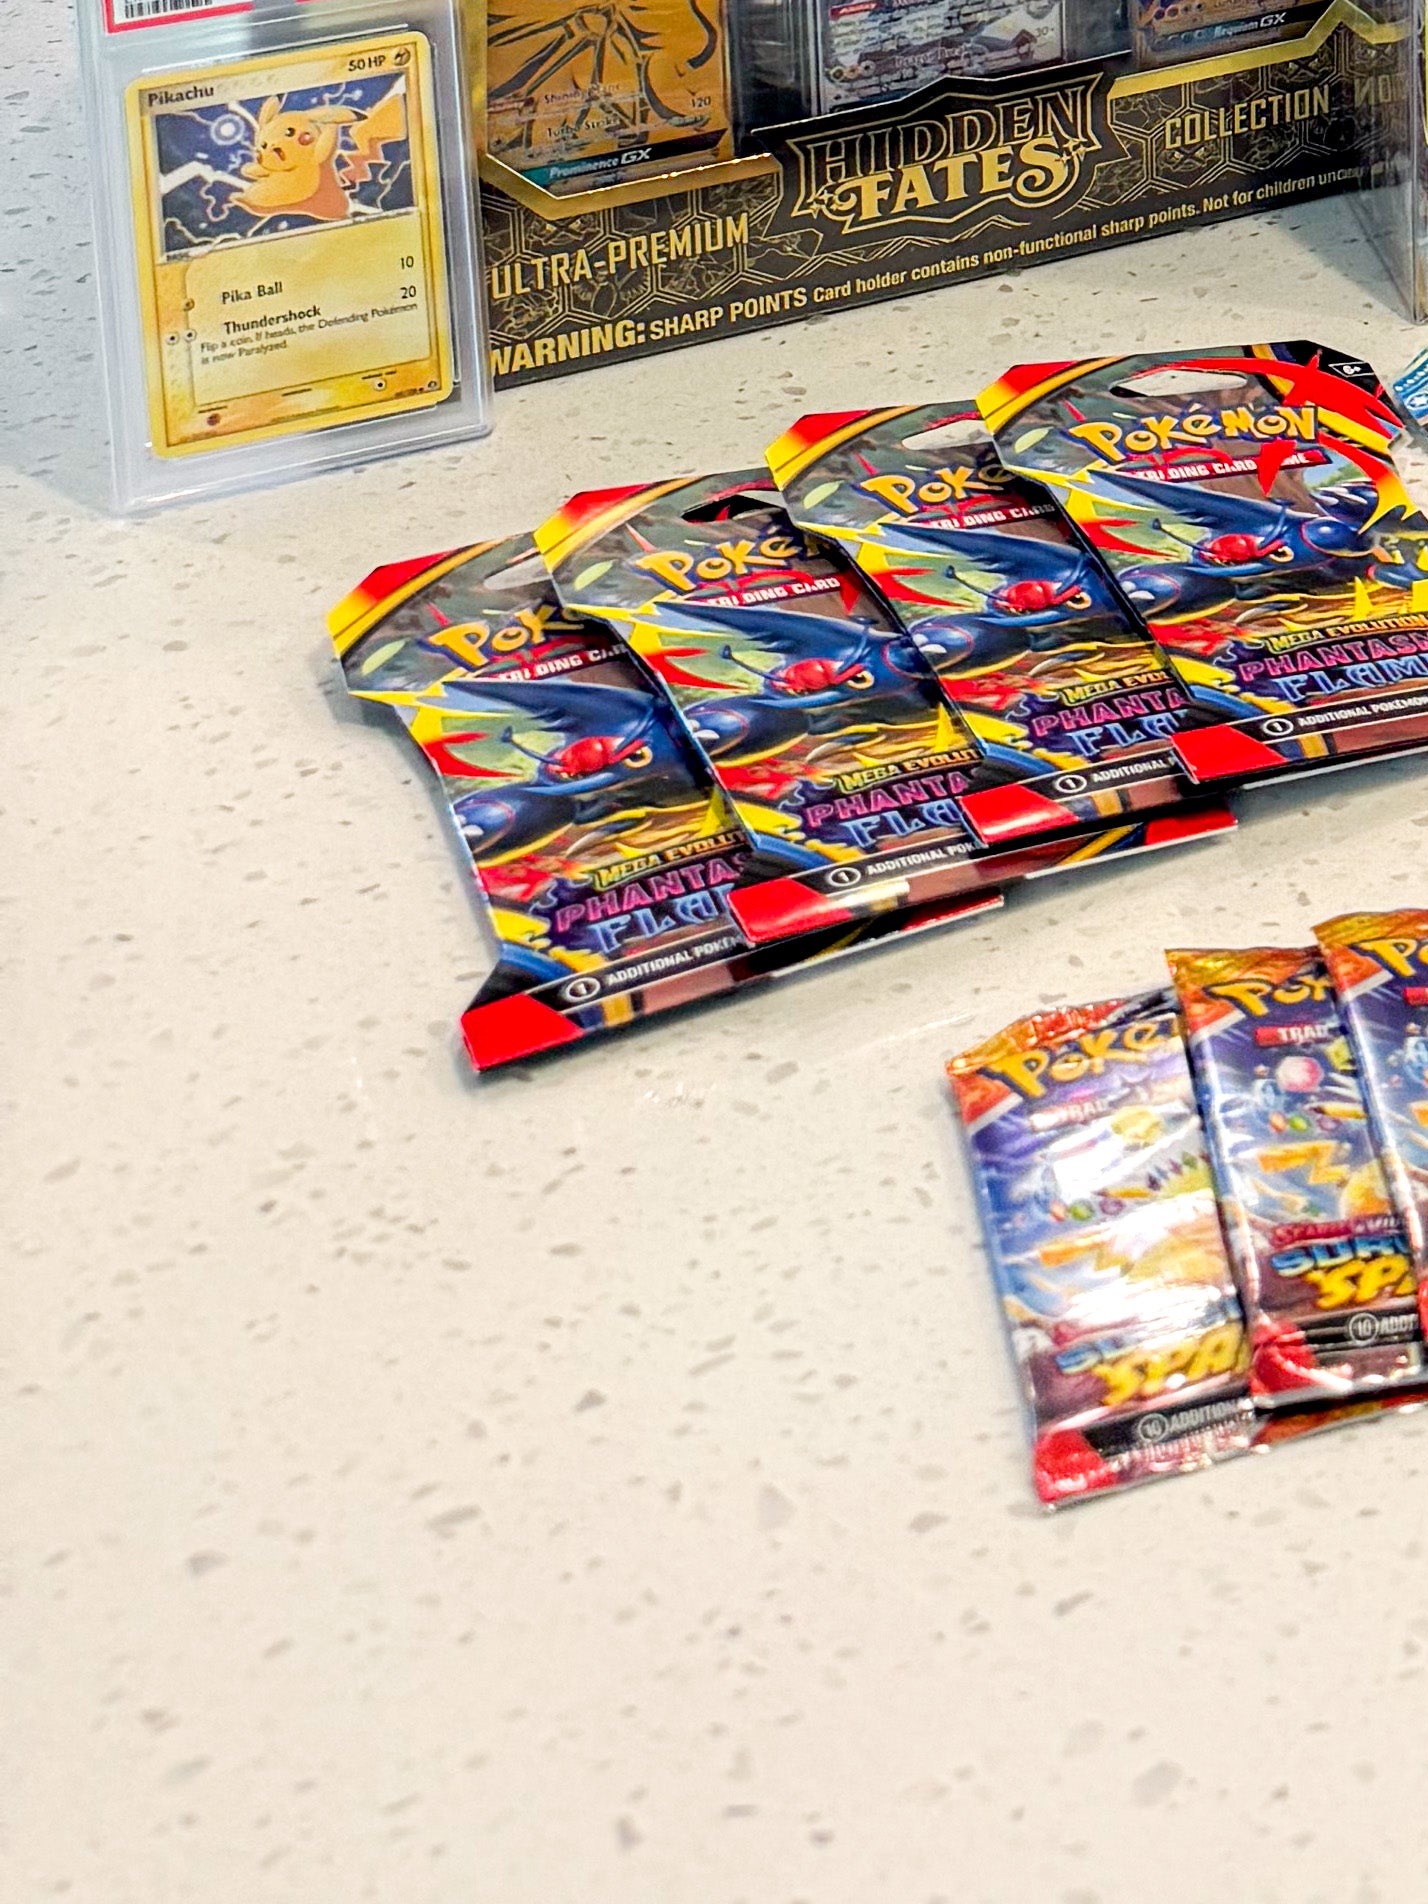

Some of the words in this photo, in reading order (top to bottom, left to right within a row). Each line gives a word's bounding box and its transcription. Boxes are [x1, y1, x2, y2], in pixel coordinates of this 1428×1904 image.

[348, 57, 365, 72] 50
[367, 54, 387, 69] HP
[147, 85, 215, 108] Pikachu
[1164, 84, 1331, 150] COLLECTION
[809, 85, 1086, 183] HIDDEN
[838, 137, 1083, 220] FATES
[491, 212, 750, 300] ULTRA-PREMIUM
[855, 268, 908, 294] holder
[911, 252, 980, 280] contains
[983, 224, 1100, 264] non-functional
[1101, 214, 1147, 241] sharp
[1149, 202, 1201, 231] points.
[1203, 193, 1232, 214] Not
[1232, 188, 1256, 208] for
[400, 256, 415, 269] 10
[221, 288, 253, 305] Pika
[256, 281, 284, 297] Ball
[400, 285, 418, 299] 20
[223, 305, 322, 336] Thundershock
[318, 312, 369, 330] Defending
[490, 321, 646, 377] WARNING:
[649, 306, 725, 342] SHARP
[730, 288, 809, 324] POINTS
[1297, 704, 1372, 729] ADDITIONAL
[599, 854, 660, 890] MEGA
